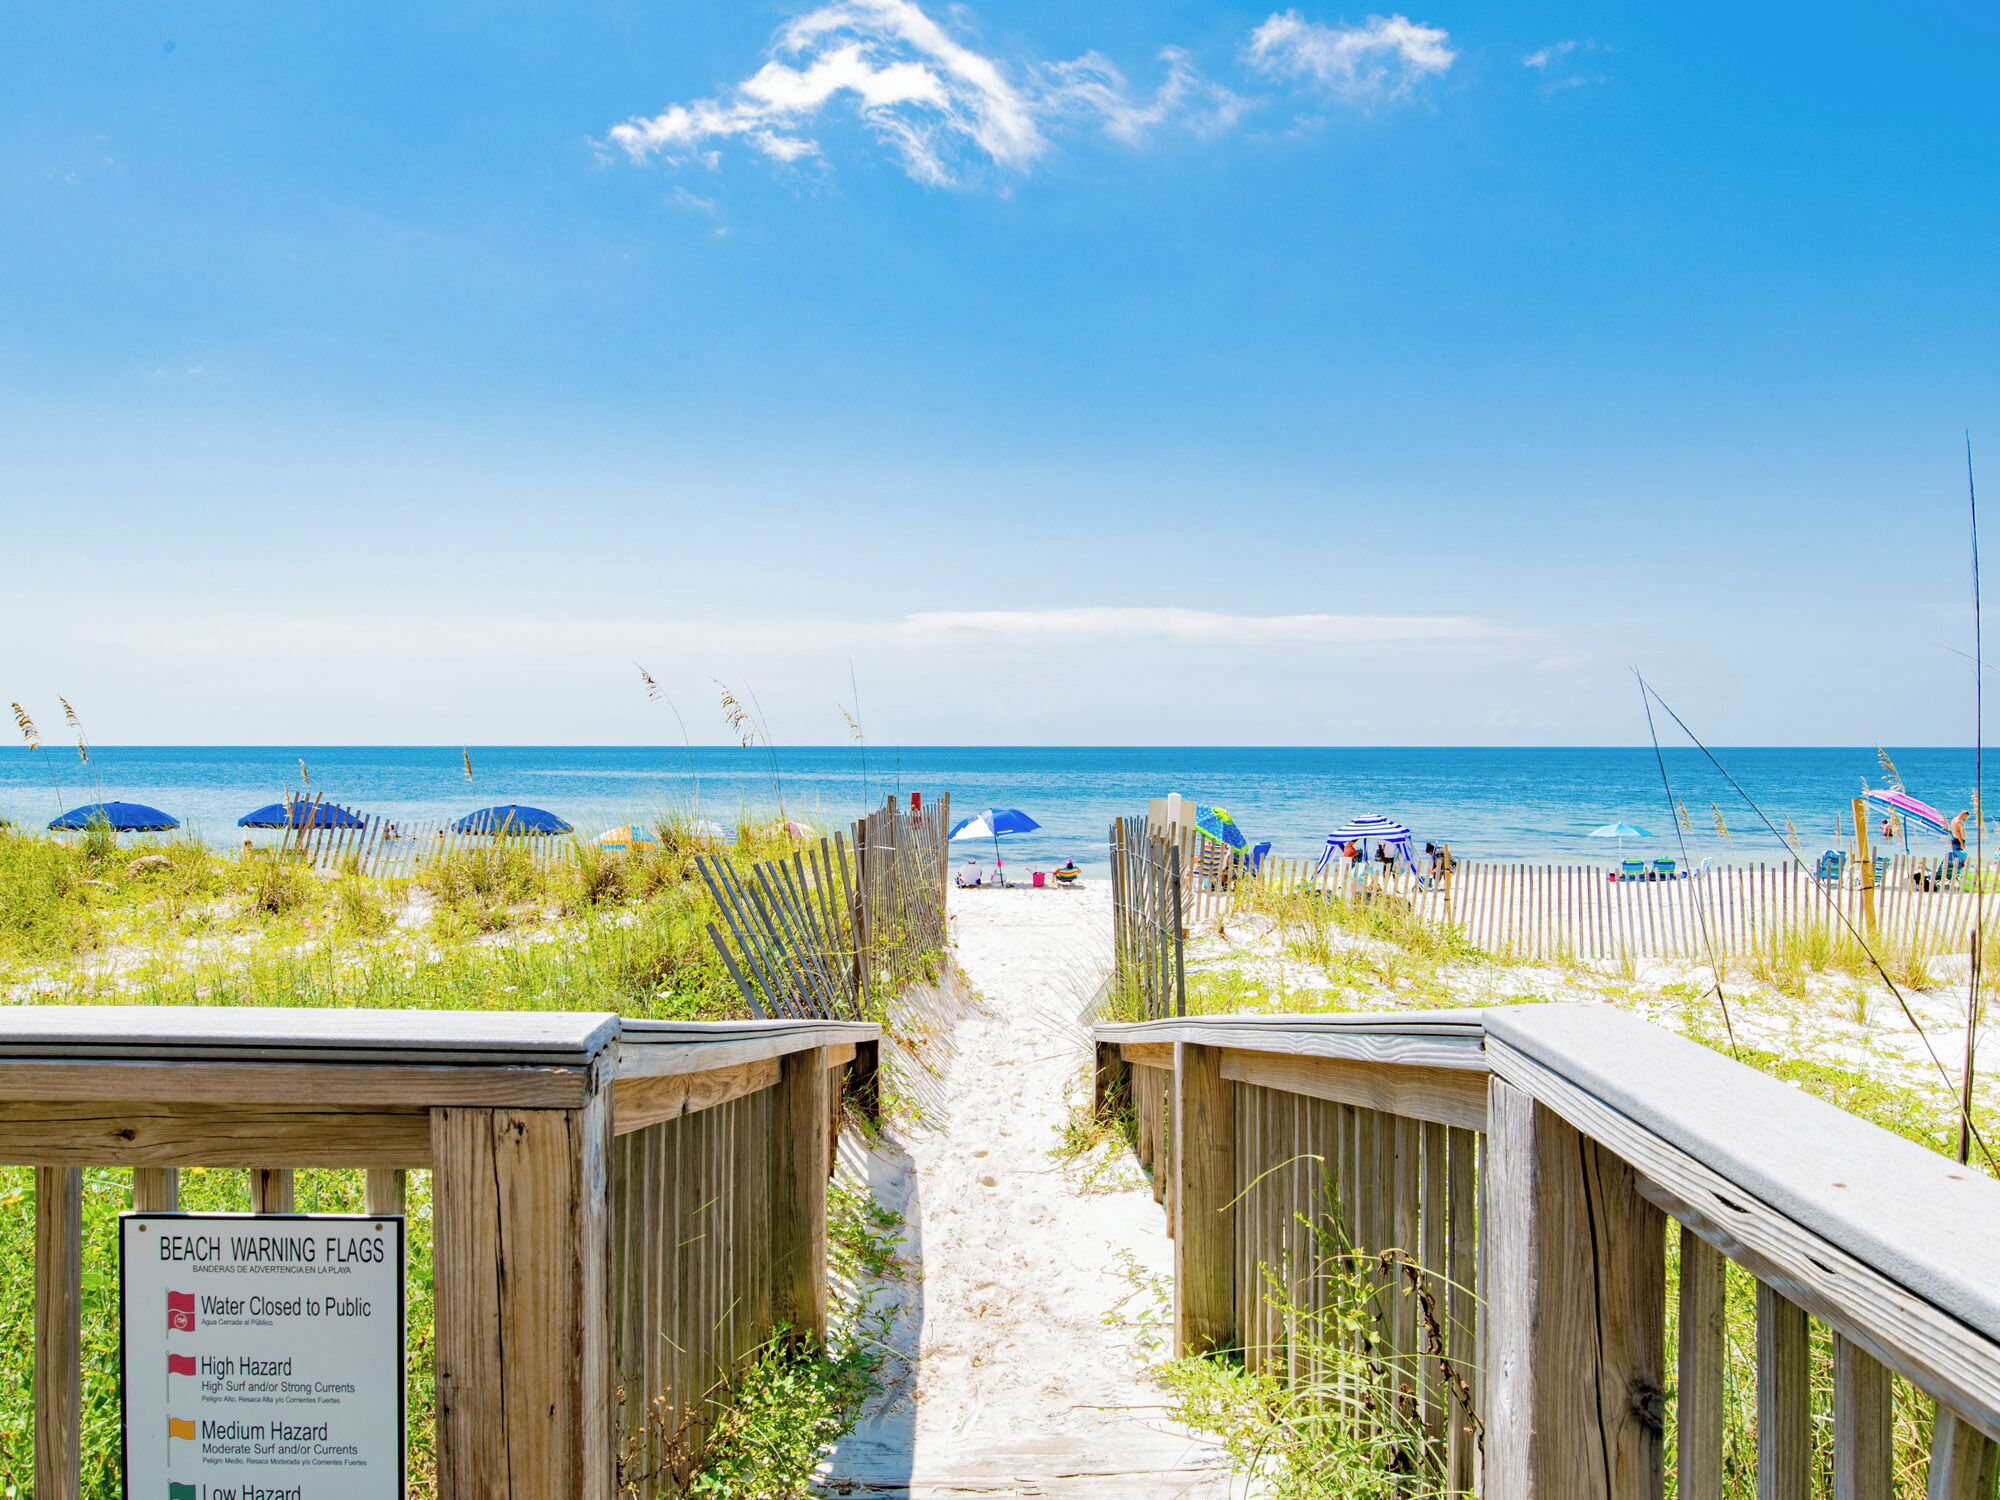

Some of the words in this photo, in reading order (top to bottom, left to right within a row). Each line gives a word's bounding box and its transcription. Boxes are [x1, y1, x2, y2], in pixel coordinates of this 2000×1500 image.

[160, 1236, 220, 1261] BEACH
[231, 1237, 315, 1262] WARNING
[326, 1238, 384, 1263] FLAGS
[192, 1265, 235, 1273] BANDERAS
[237, 1265, 248, 1273] DE
[249, 1266, 304, 1274] ADVERTENCIA
[305, 1266, 316, 1274] EN
[318, 1266, 327, 1274] LA
[328, 1266, 351, 1274] PLAYA
[201, 1295, 245, 1316] Water
[249, 1296, 301, 1316] Closed
[307, 1298, 320, 1316] to
[325, 1297, 371, 1317] Public
[201, 1356, 234, 1380] High
[240, 1357, 292, 1376] Hazard
[201, 1381, 223, 1393] High
[226, 1381, 246, 1392] Surf
[248, 1381, 278, 1392] and/or
[281, 1382, 312, 1395] Strong
[315, 1382, 355, 1393] Currents
[202, 1420, 265, 1440] Medium
[271, 1421, 328, 1441] Hazard
[202, 1444, 251, 1454] Moderate
[254, 1444, 275, 1455] Surf
[278, 1444, 311, 1455] and/or
[314, 1444, 358, 1455] Currents
[203, 1484, 237, 1500] Low
[243, 1485, 301, 1500] Hazard
